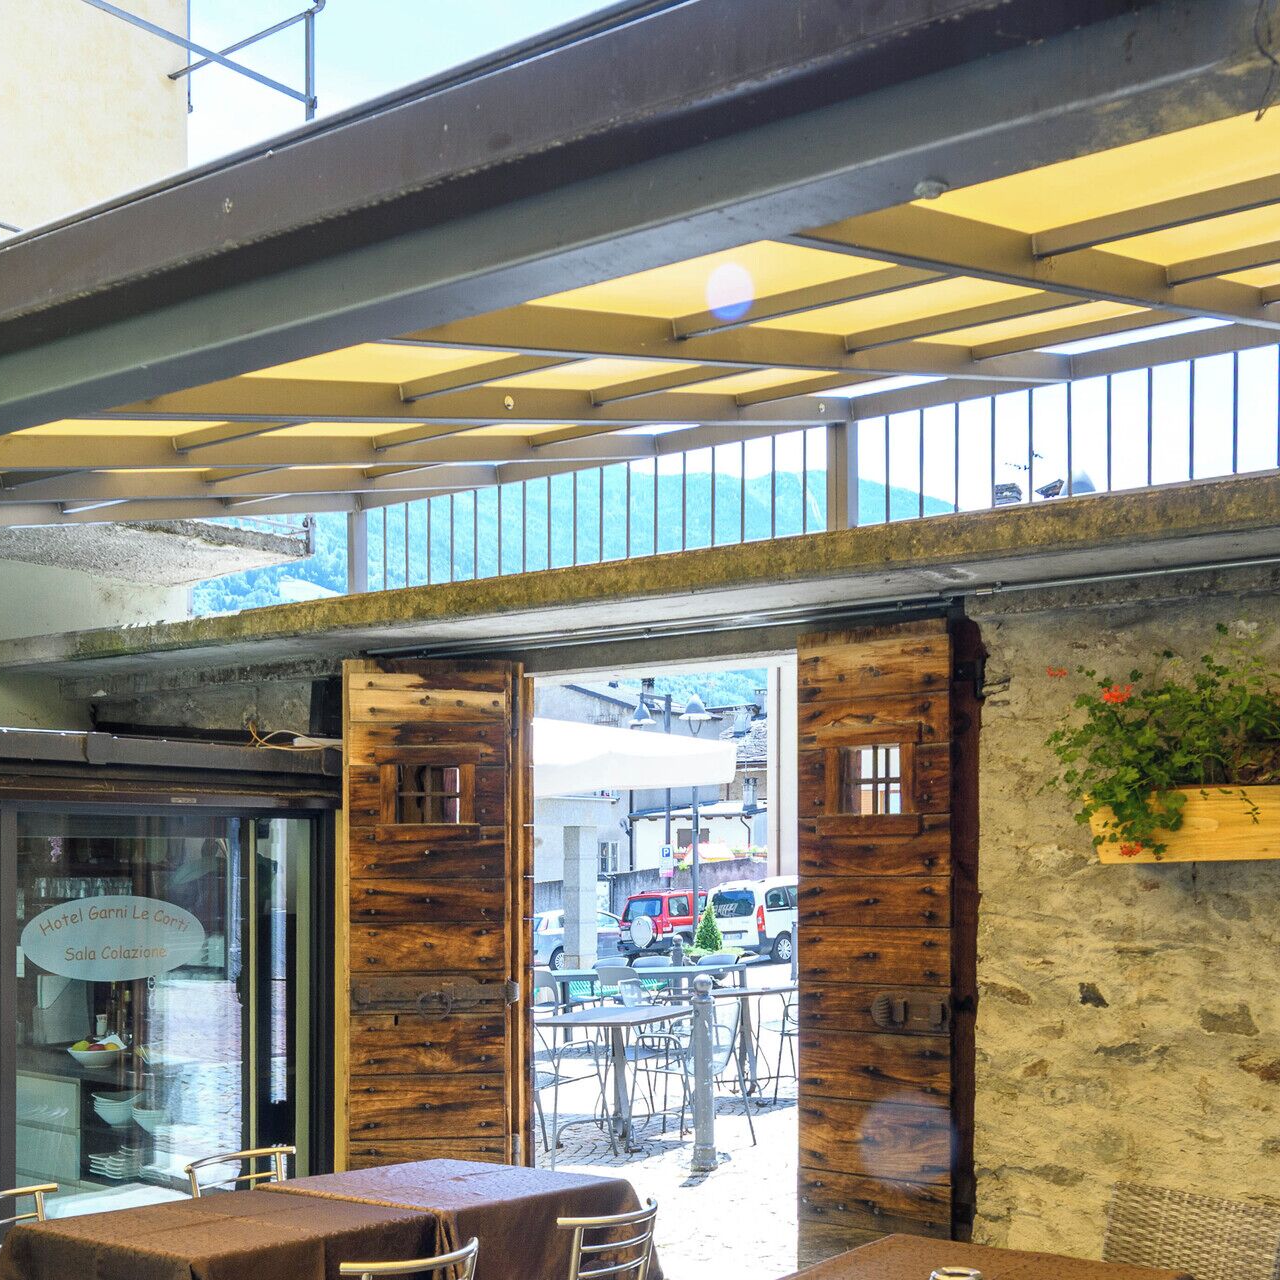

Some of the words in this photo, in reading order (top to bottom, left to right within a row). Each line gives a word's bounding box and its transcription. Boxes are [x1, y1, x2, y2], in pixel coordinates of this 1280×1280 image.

[39, 907, 83, 936] Hotel
[88, 905, 128, 921] Garni
[133, 905, 149, 920] Le
[154, 909, 190, 932] Corti
[64, 946, 96, 961] Sala
[101, 945, 167, 960] Colazione
